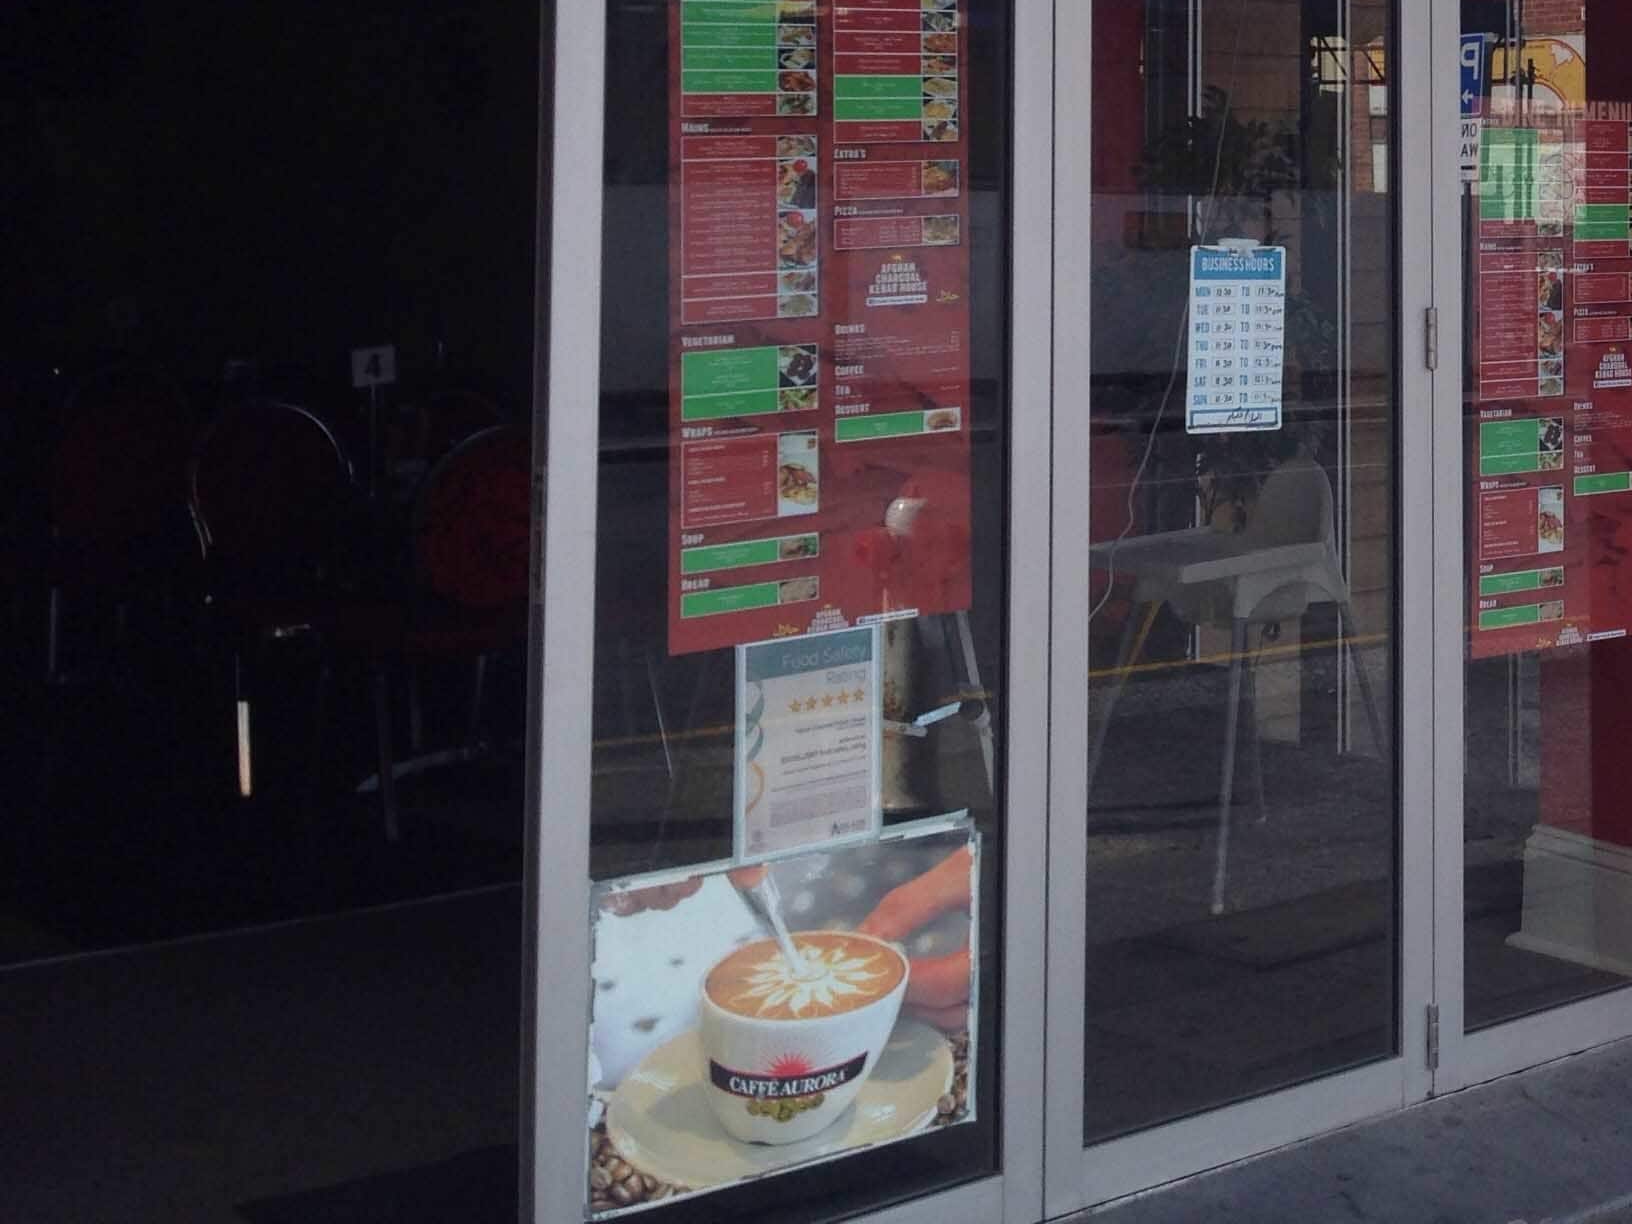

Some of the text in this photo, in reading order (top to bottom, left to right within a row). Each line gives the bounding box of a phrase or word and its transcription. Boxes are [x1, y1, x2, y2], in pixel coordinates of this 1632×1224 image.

[1201, 256, 1275, 272] BUSINESS HOURS
[781, 1071, 845, 1095] AURORA
